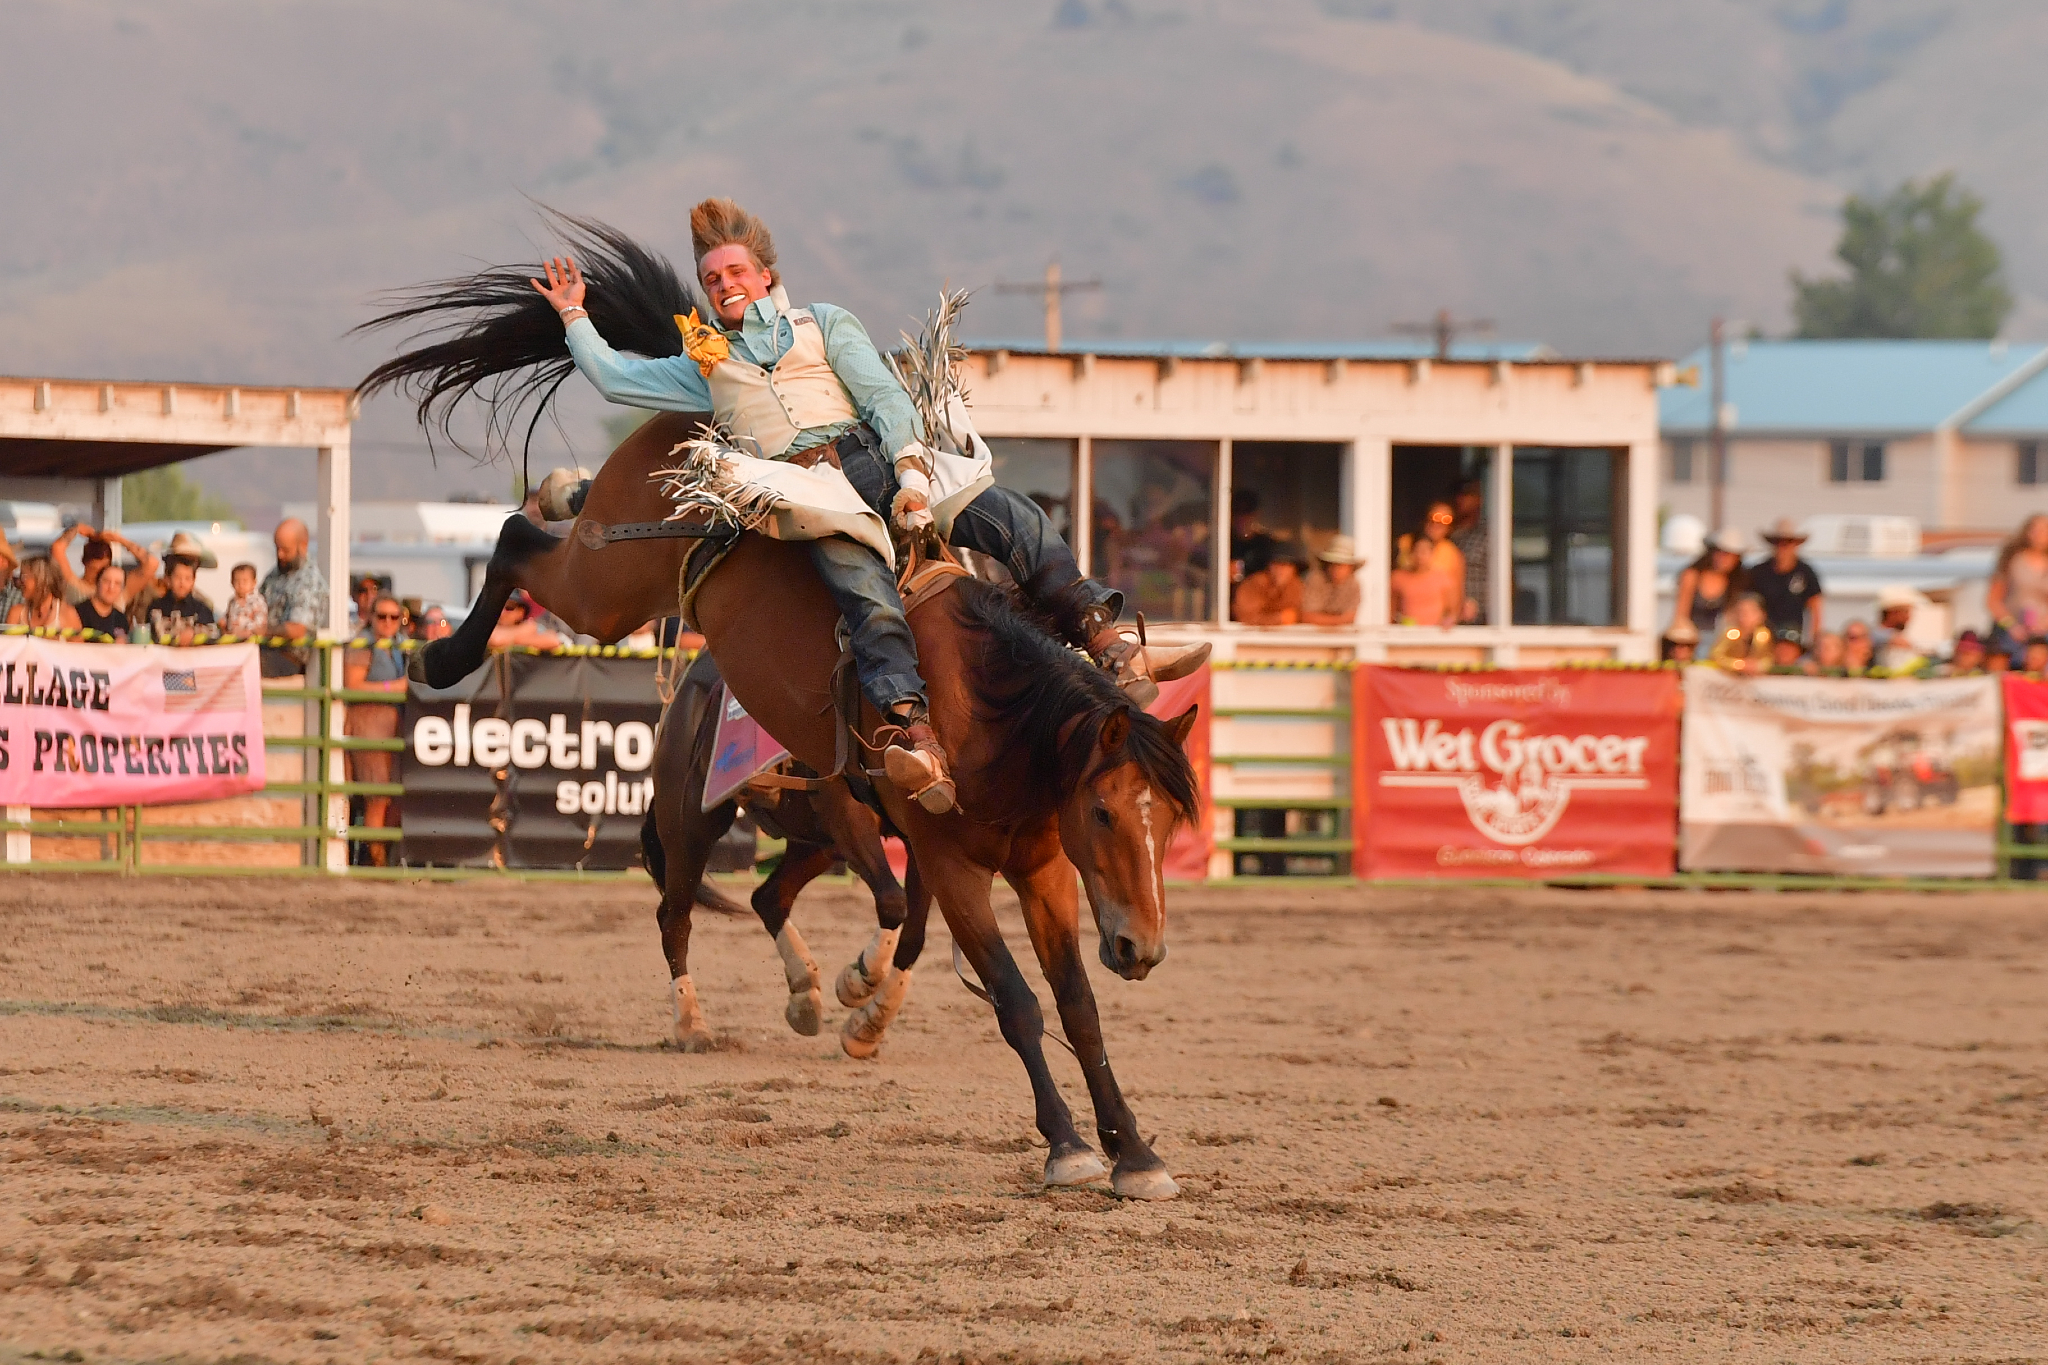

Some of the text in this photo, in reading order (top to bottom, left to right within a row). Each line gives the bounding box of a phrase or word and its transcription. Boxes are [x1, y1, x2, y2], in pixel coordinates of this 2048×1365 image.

[0, 660, 111, 712] LLAGE
[33, 727, 249, 776] PROPERTIES
[413, 703, 659, 772] electro
[1380, 717, 1650, 774] Wet Grocer
